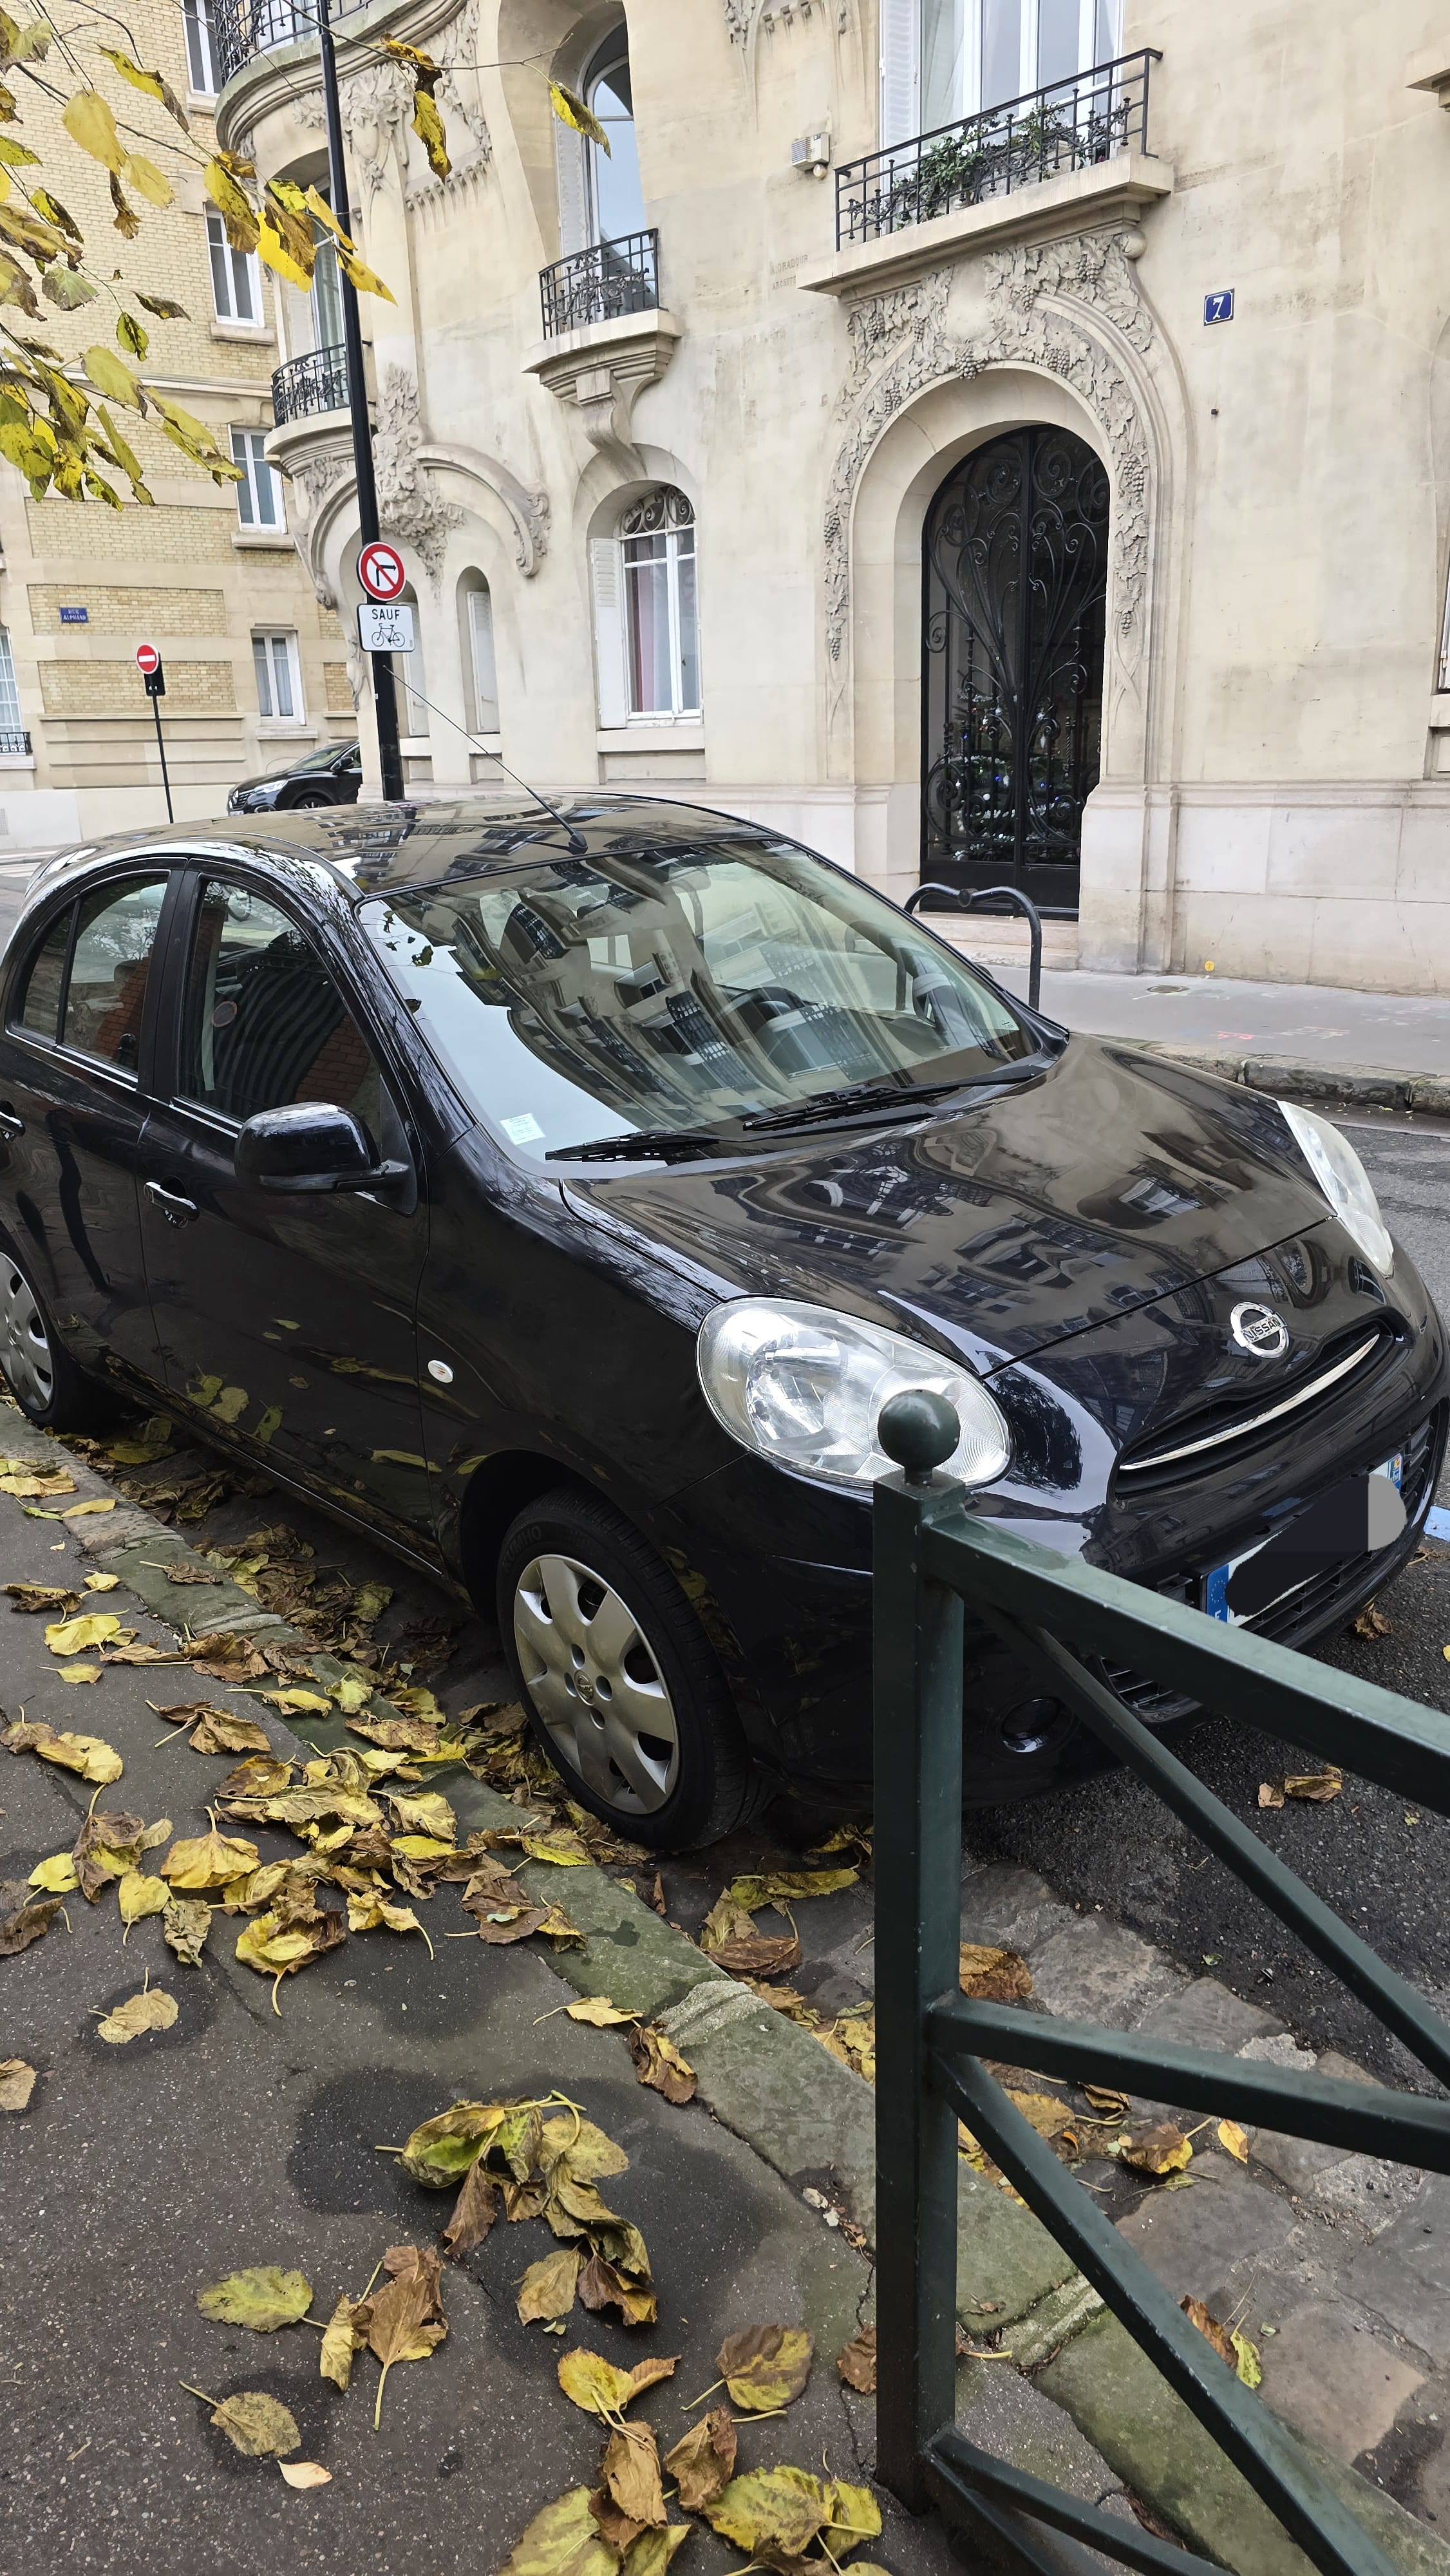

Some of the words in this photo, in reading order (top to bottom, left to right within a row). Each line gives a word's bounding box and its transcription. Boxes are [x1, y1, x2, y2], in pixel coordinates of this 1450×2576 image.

[1212, 296, 1225, 319] 7
[372, 609, 400, 620] SAUF
[1243, 1317, 1281, 1341] NISSAN
